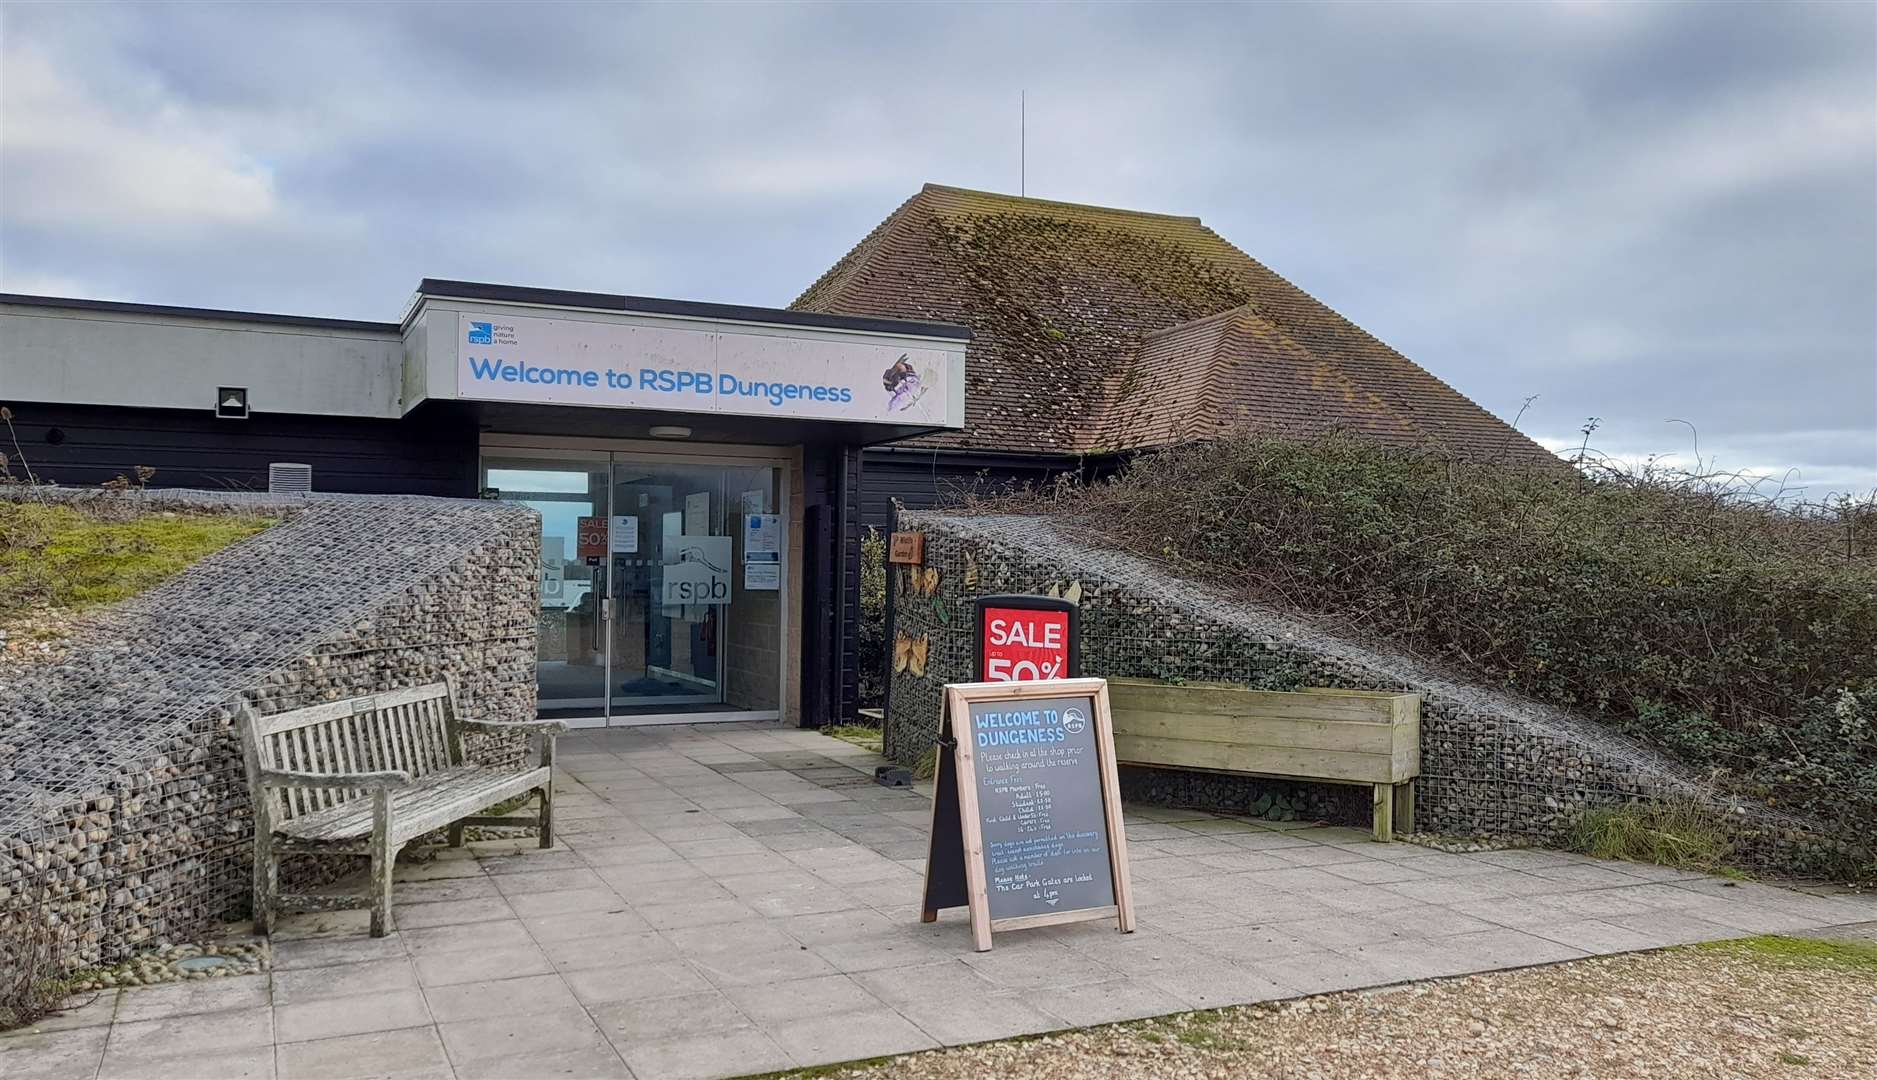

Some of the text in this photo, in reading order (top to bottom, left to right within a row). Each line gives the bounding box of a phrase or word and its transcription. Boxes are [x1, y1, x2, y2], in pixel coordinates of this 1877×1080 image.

[471, 336, 490, 344] rspb
[469, 357, 852, 406] Welcome to RSPB Dungeness
[580, 520, 608, 529] SALE
[668, 576, 726, 607] rspb
[990, 619, 1061, 648] SALE
[976, 710, 1058, 728] WELCOME TO
[978, 728, 1065, 747] DUNGENESS
[980, 746, 1084, 762] Please check in at the shop prior
[986, 758, 1078, 774] to walking around the reserve
[1026, 880, 1040, 888] Park
[1042, 878, 1061, 886] Gates
[1033, 888, 1059, 899] at 4pm
